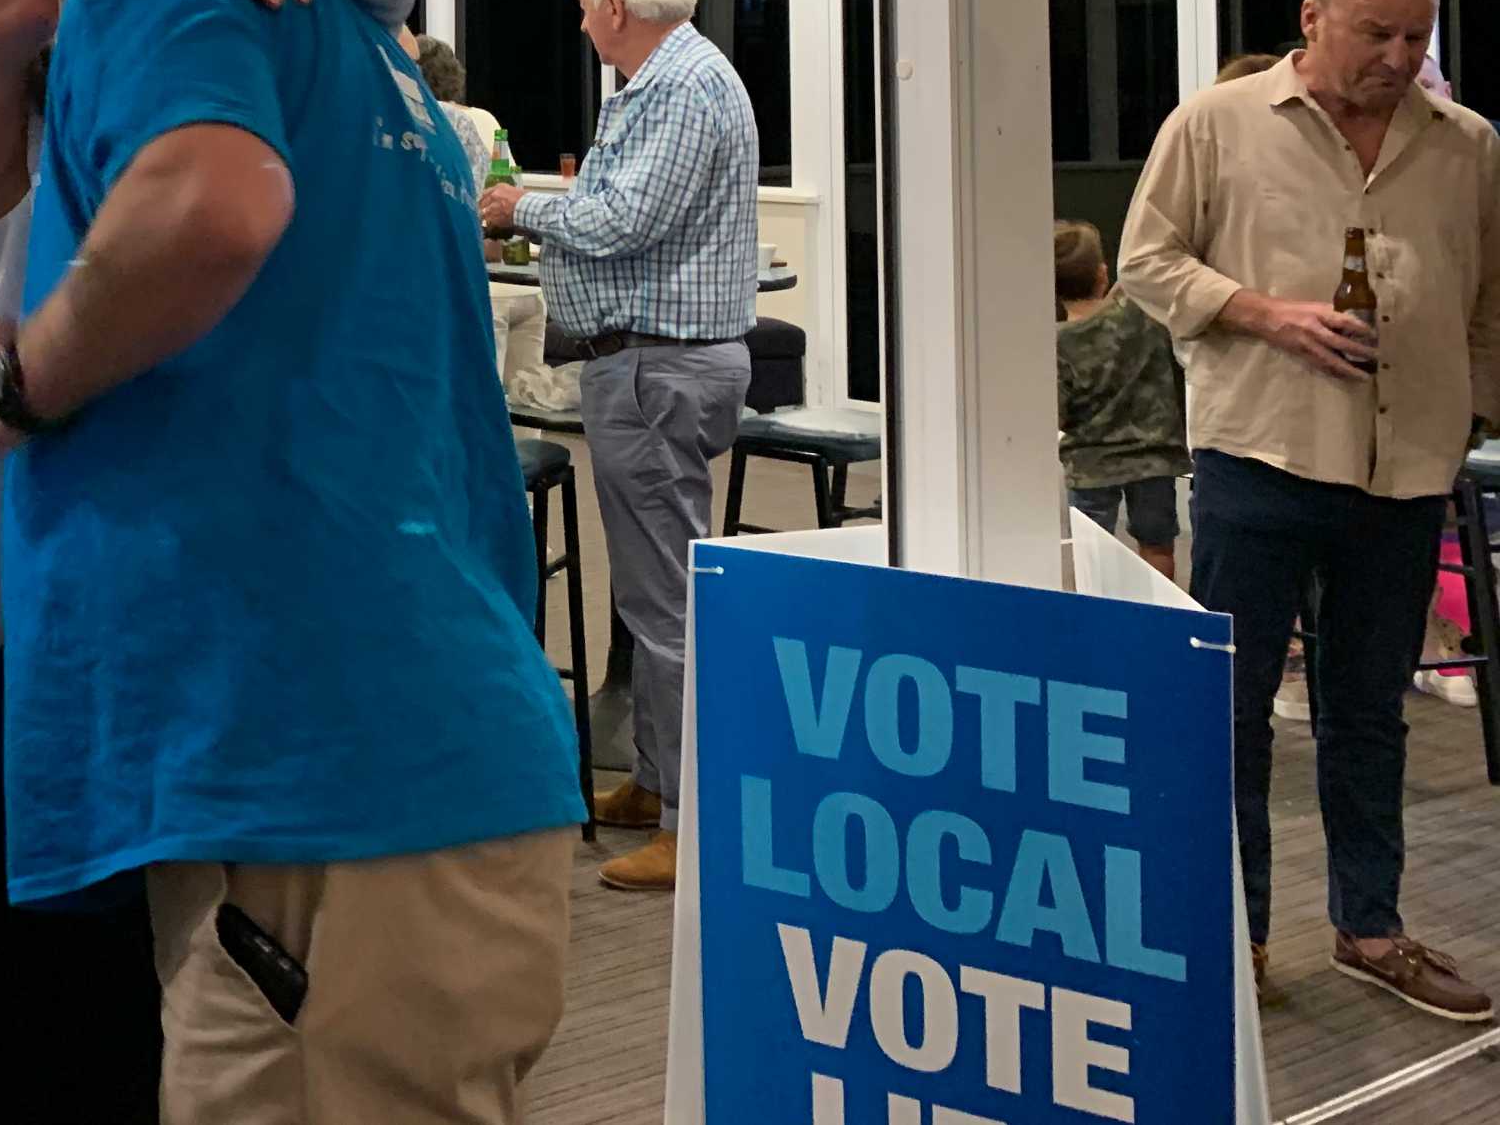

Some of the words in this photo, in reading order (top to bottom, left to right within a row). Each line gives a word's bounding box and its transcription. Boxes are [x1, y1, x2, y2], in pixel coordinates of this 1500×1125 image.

[772, 636, 1131, 815] VOTE
[740, 774, 1187, 982] LOCAL
[776, 922, 1135, 1124] VOTE
